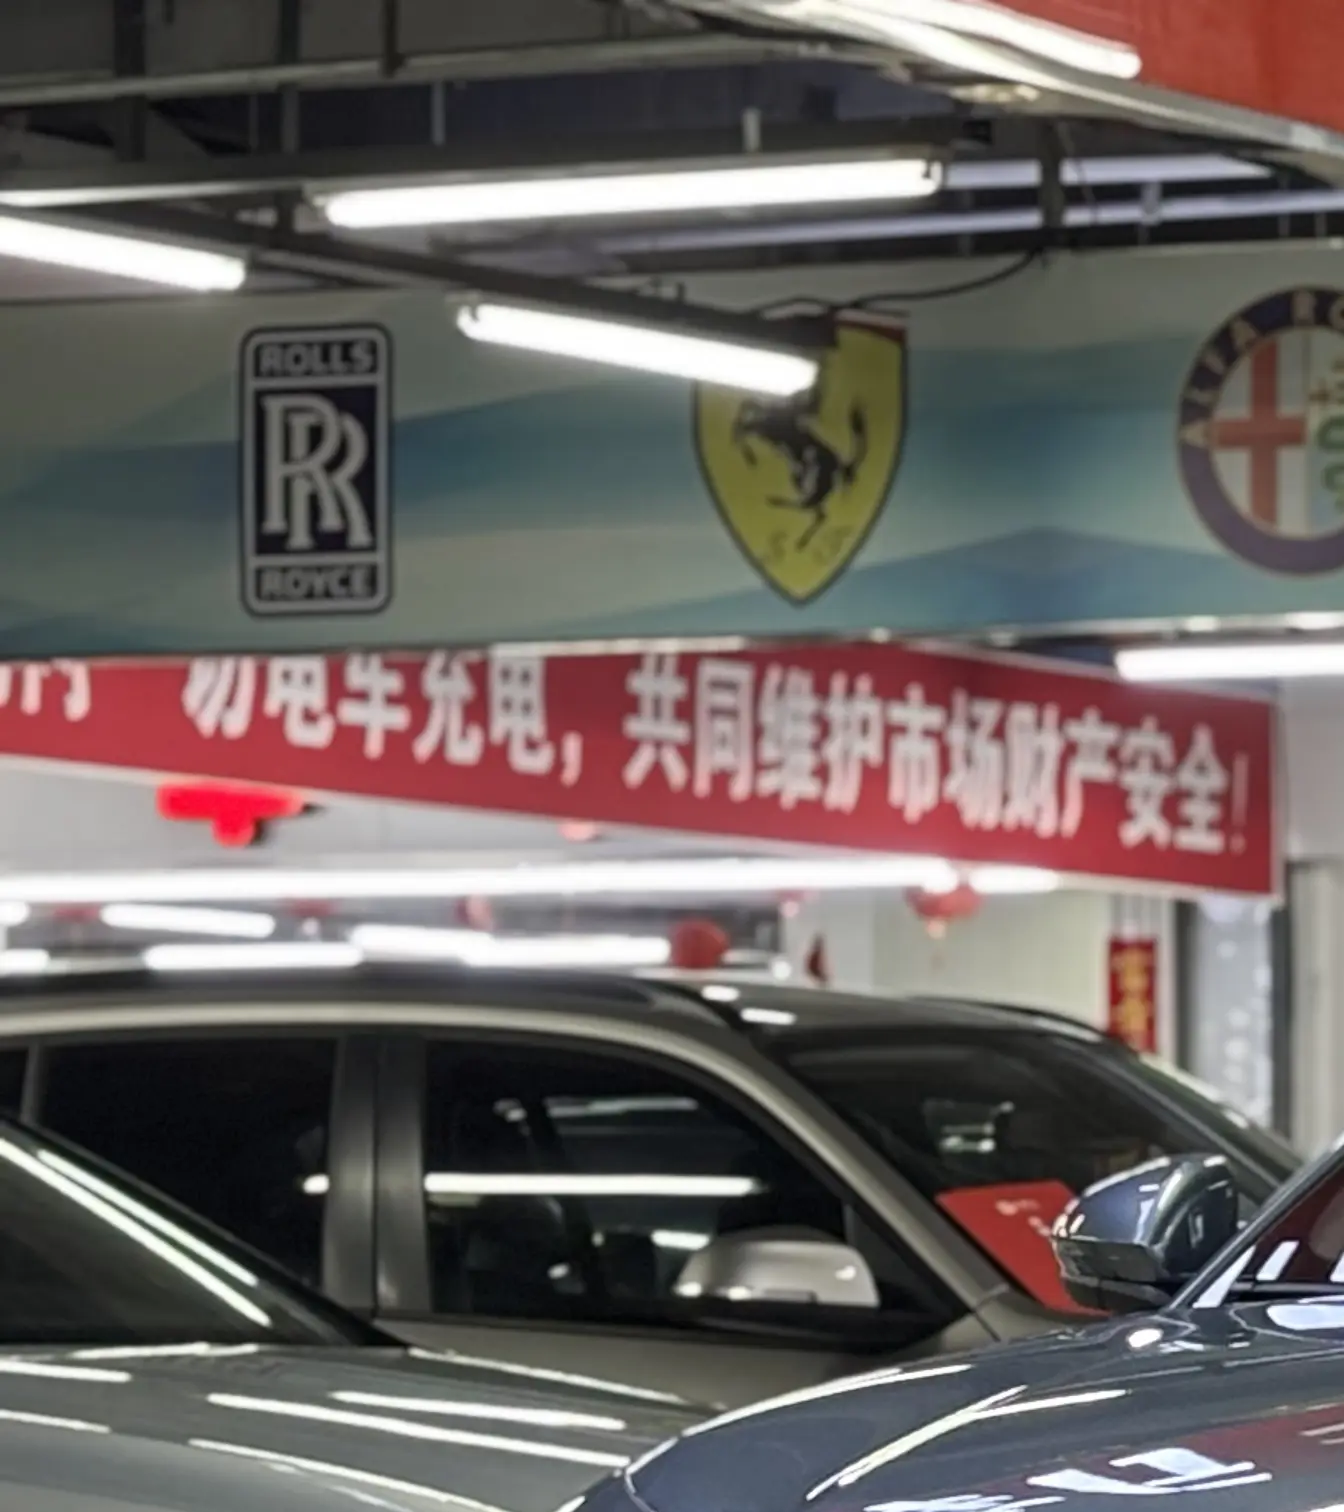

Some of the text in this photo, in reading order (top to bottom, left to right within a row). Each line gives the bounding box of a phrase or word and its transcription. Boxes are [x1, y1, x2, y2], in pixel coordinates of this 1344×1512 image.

[258, 340, 374, 376] ROLLS
[1179, 317, 1259, 449] ALFA
[258, 566, 374, 600] ROYCE
